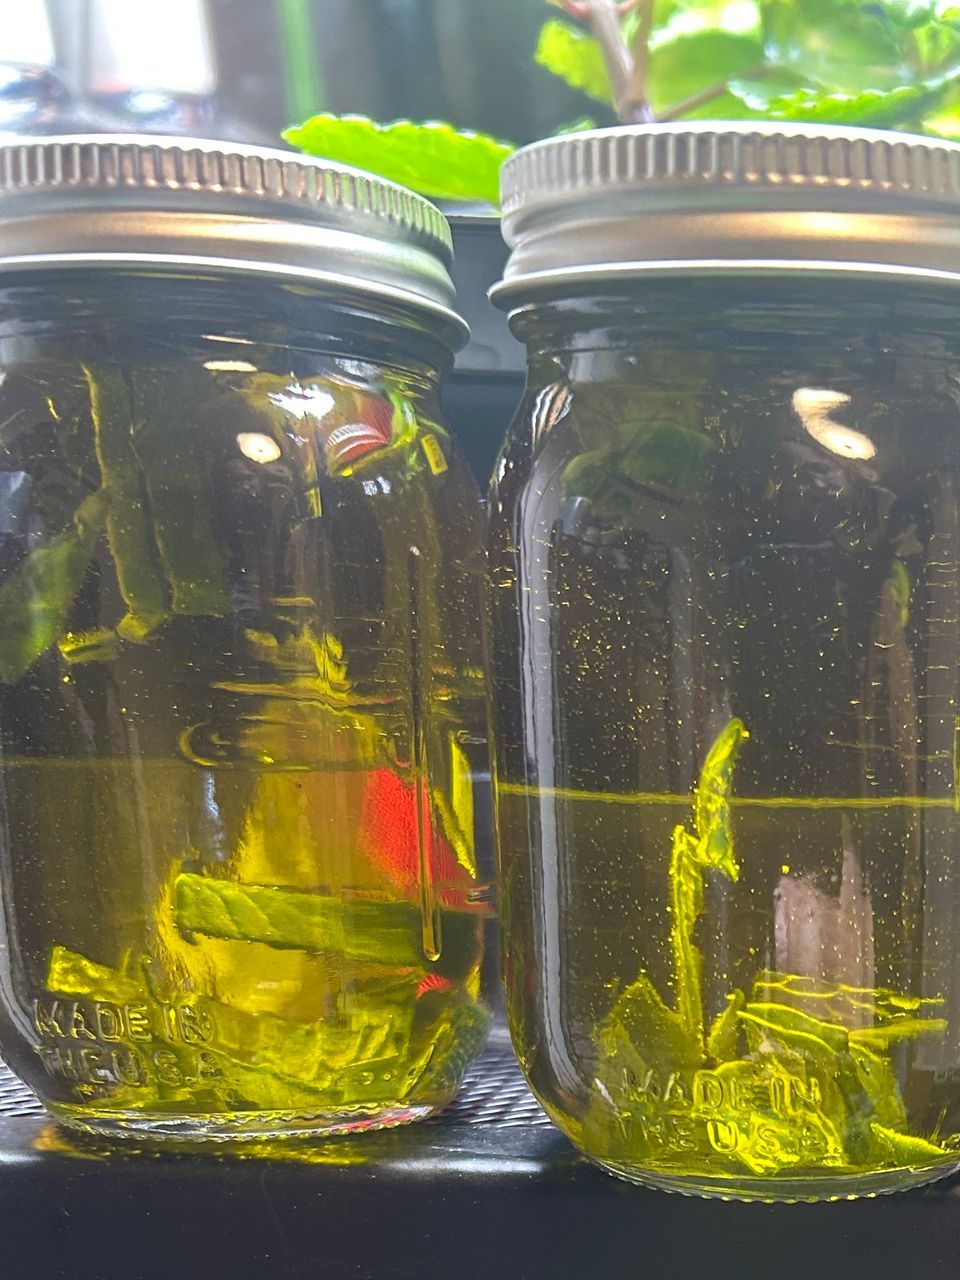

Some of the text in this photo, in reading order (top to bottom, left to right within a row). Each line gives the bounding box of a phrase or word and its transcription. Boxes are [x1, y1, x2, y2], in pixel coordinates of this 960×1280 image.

[34, 999, 215, 1044] MADE IN
[621, 1067, 752, 1112] MADE
